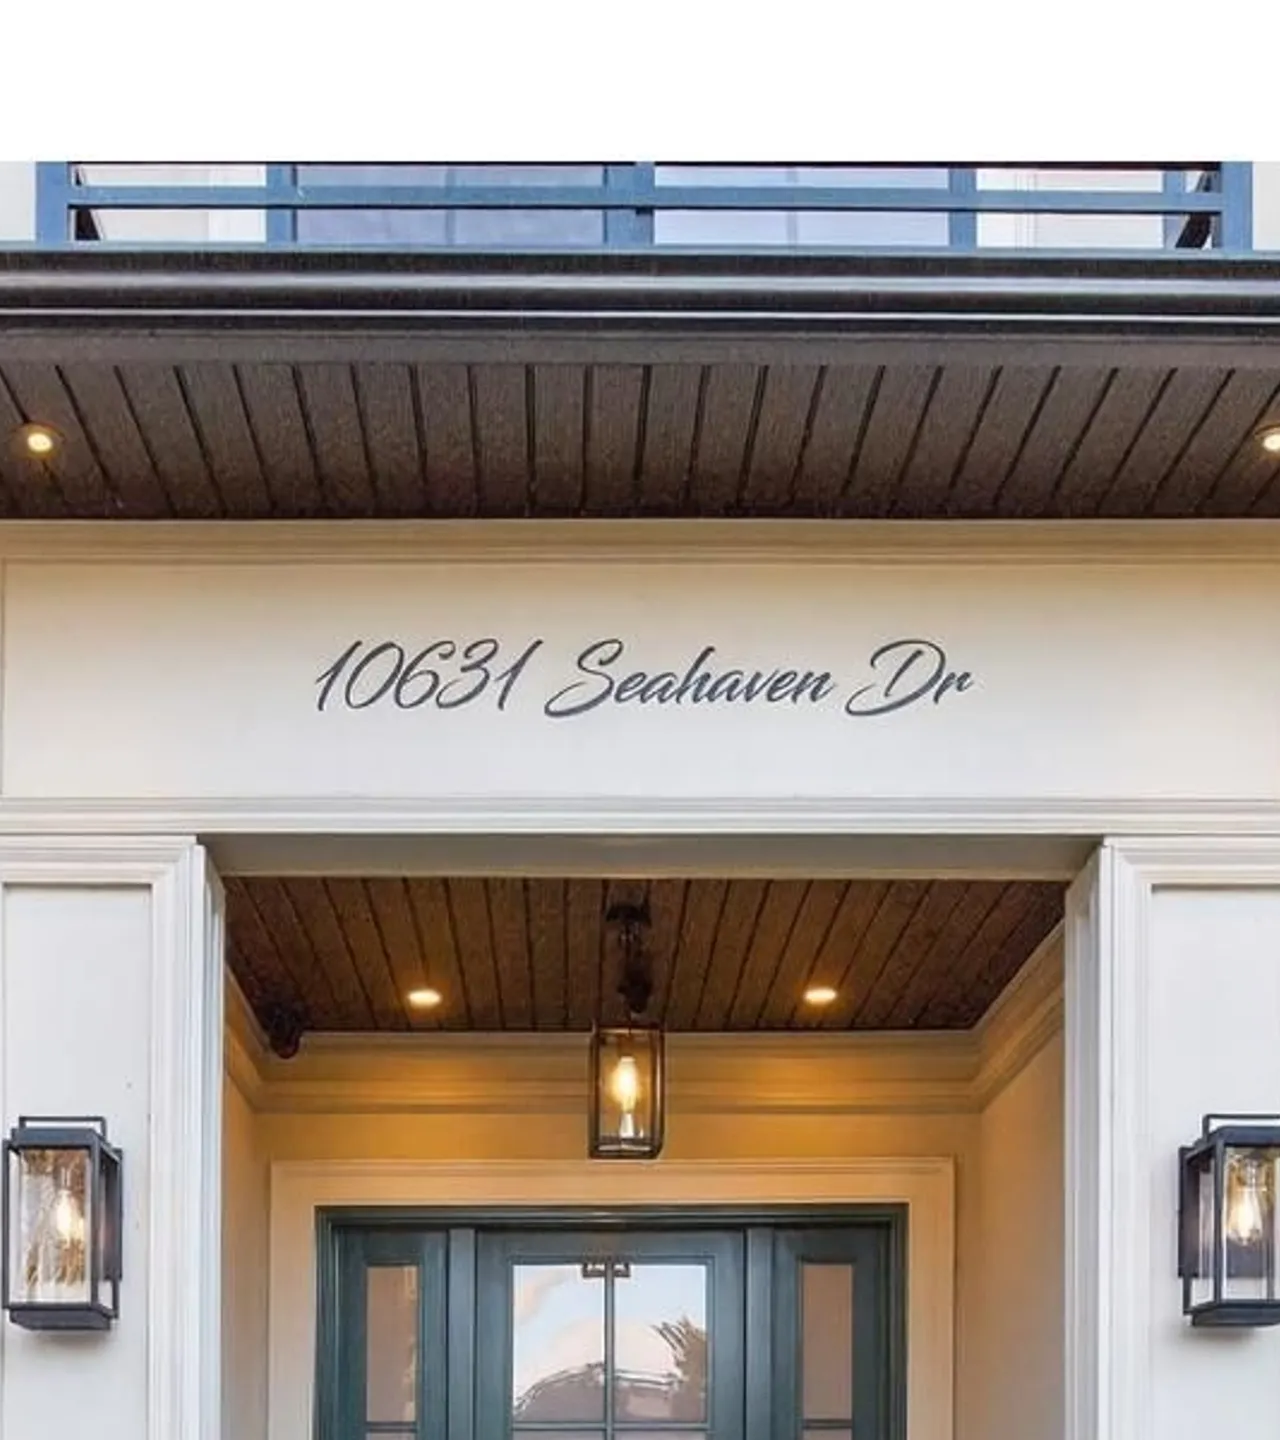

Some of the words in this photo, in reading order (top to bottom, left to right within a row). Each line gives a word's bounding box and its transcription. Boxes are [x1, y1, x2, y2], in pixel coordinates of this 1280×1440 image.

[315, 637, 544, 712] 10631
[543, 638, 835, 718] Seahaven
[844, 638, 975, 718] Dr
